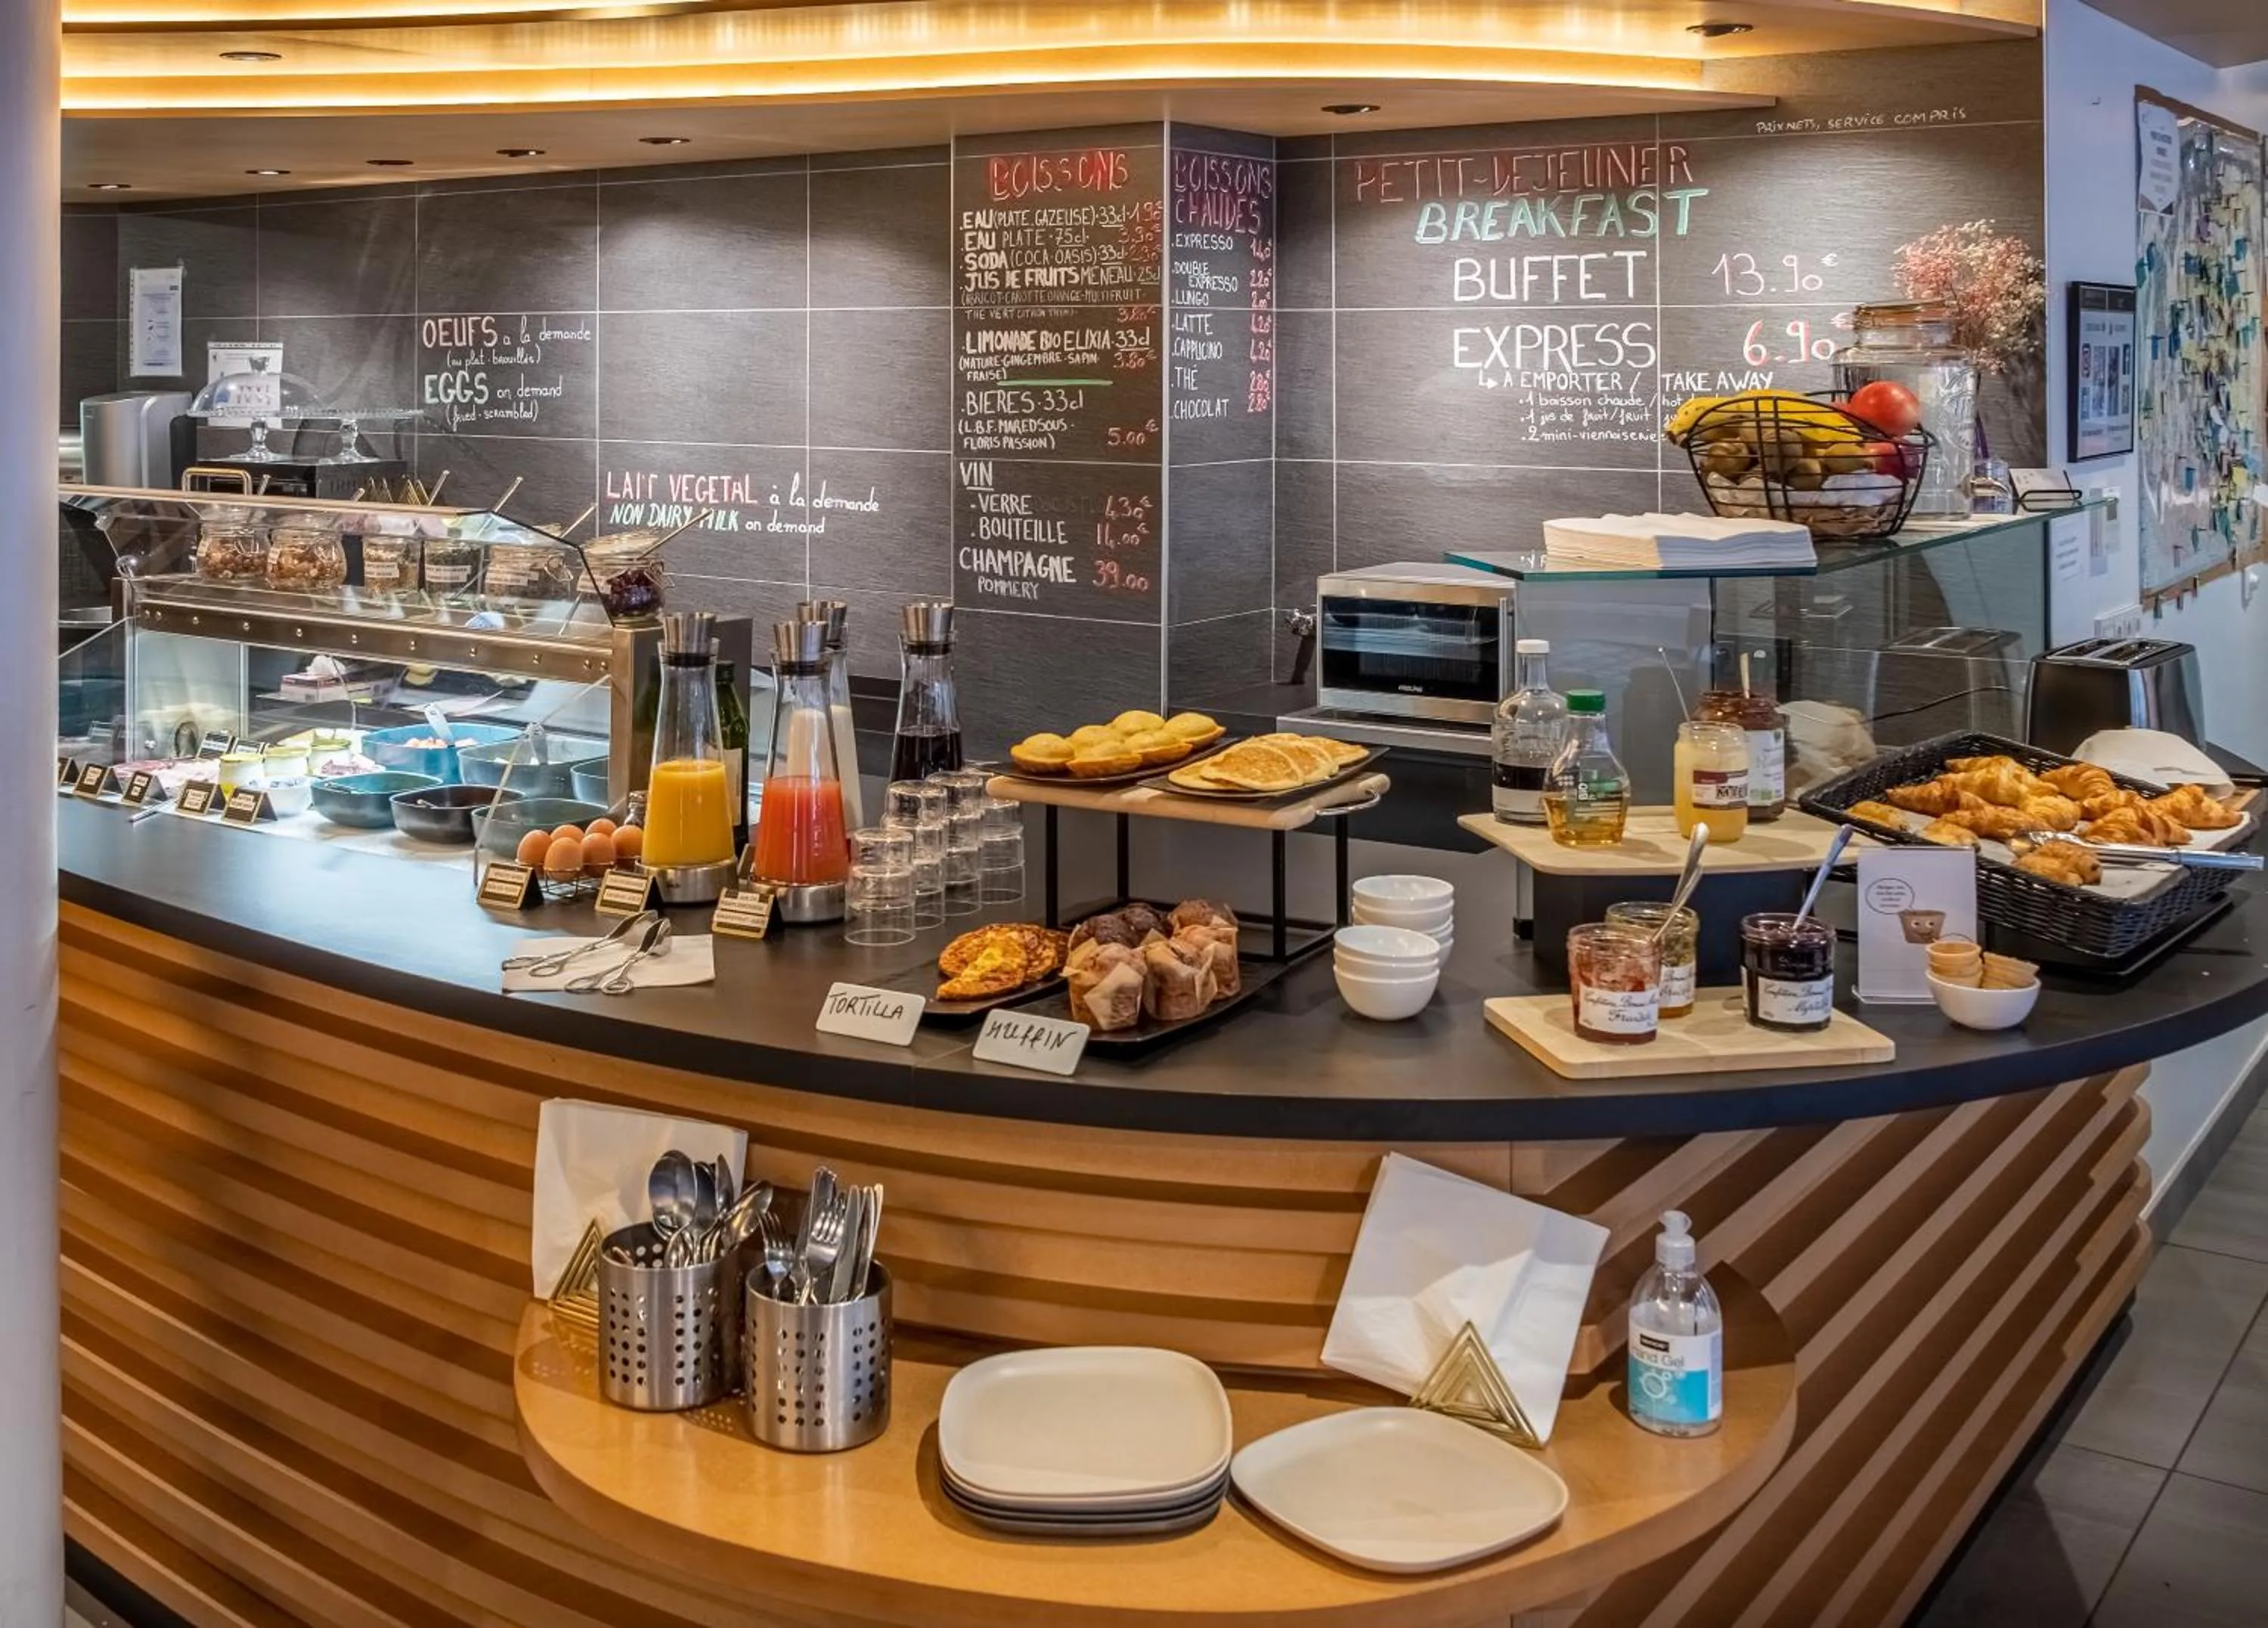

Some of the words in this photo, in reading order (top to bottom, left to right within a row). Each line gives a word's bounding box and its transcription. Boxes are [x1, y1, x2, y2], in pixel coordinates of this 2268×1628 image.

[990, 150, 1129, 202] BOISSONS
[1174, 153, 1272, 199] BOISSONS
[962, 209, 993, 229] EAU
[1176, 191, 1260, 234] CHAUDES
[1414, 187, 1709, 244] BREAKFAST
[964, 230, 996, 252] EAU
[1002, 228, 1046, 249] PLATE
[1176, 234, 1233, 251] EXPRESSO
[964, 250, 1009, 271] SODA
[965, 271, 1000, 292] JUS
[1024, 266, 1080, 287] FRUITS
[1188, 275, 1238, 292] EXPRESSO
[1453, 250, 1647, 302] BUFFET
[1176, 289, 1210, 306] LUNGO
[423, 315, 498, 348] OEUFS
[519, 315, 531, 344] la
[539, 317, 591, 341] demande
[1176, 312, 1213, 336] LATTE
[965, 330, 1038, 354] LIMONADE
[1453, 322, 1657, 372] EXPRESS
[424, 370, 489, 404] EGGS
[497, 387, 511, 400] on
[516, 373, 563, 398] demand
[1520, 370, 1623, 393] EMPORTER
[1661, 371, 1712, 392] TAKE
[1716, 370, 1773, 390] AWAY
[966, 389, 1035, 416] BIERES
[1173, 398, 1229, 420] CHOCOLAT
[1538, 393, 1592, 407] boisson
[1597, 392, 1646, 407] chaude
[1662, 393, 1682, 407] hot
[1540, 414, 1556, 426] jus
[1560, 408, 1575, 422] de
[963, 436, 1000, 450] FLORIS
[959, 461, 993, 486] VIN
[606, 472, 658, 500] LAIT
[669, 474, 758, 504] VEGETAL
[789, 472, 806, 507] la
[812, 480, 881, 512] demande
[978, 493, 1033, 515] VERRE
[609, 503, 643, 525] NON
[647, 503, 693, 527] DAIRY
[745, 519, 762, 531] on
[767, 509, 826, 534] demand
[979, 516, 1068, 544] BOUTEILLE
[959, 546, 1077, 583] CHAMPAGNE
[978, 575, 1039, 599] POMMERY
[985, 1020, 1078, 1051] MUFFIN
